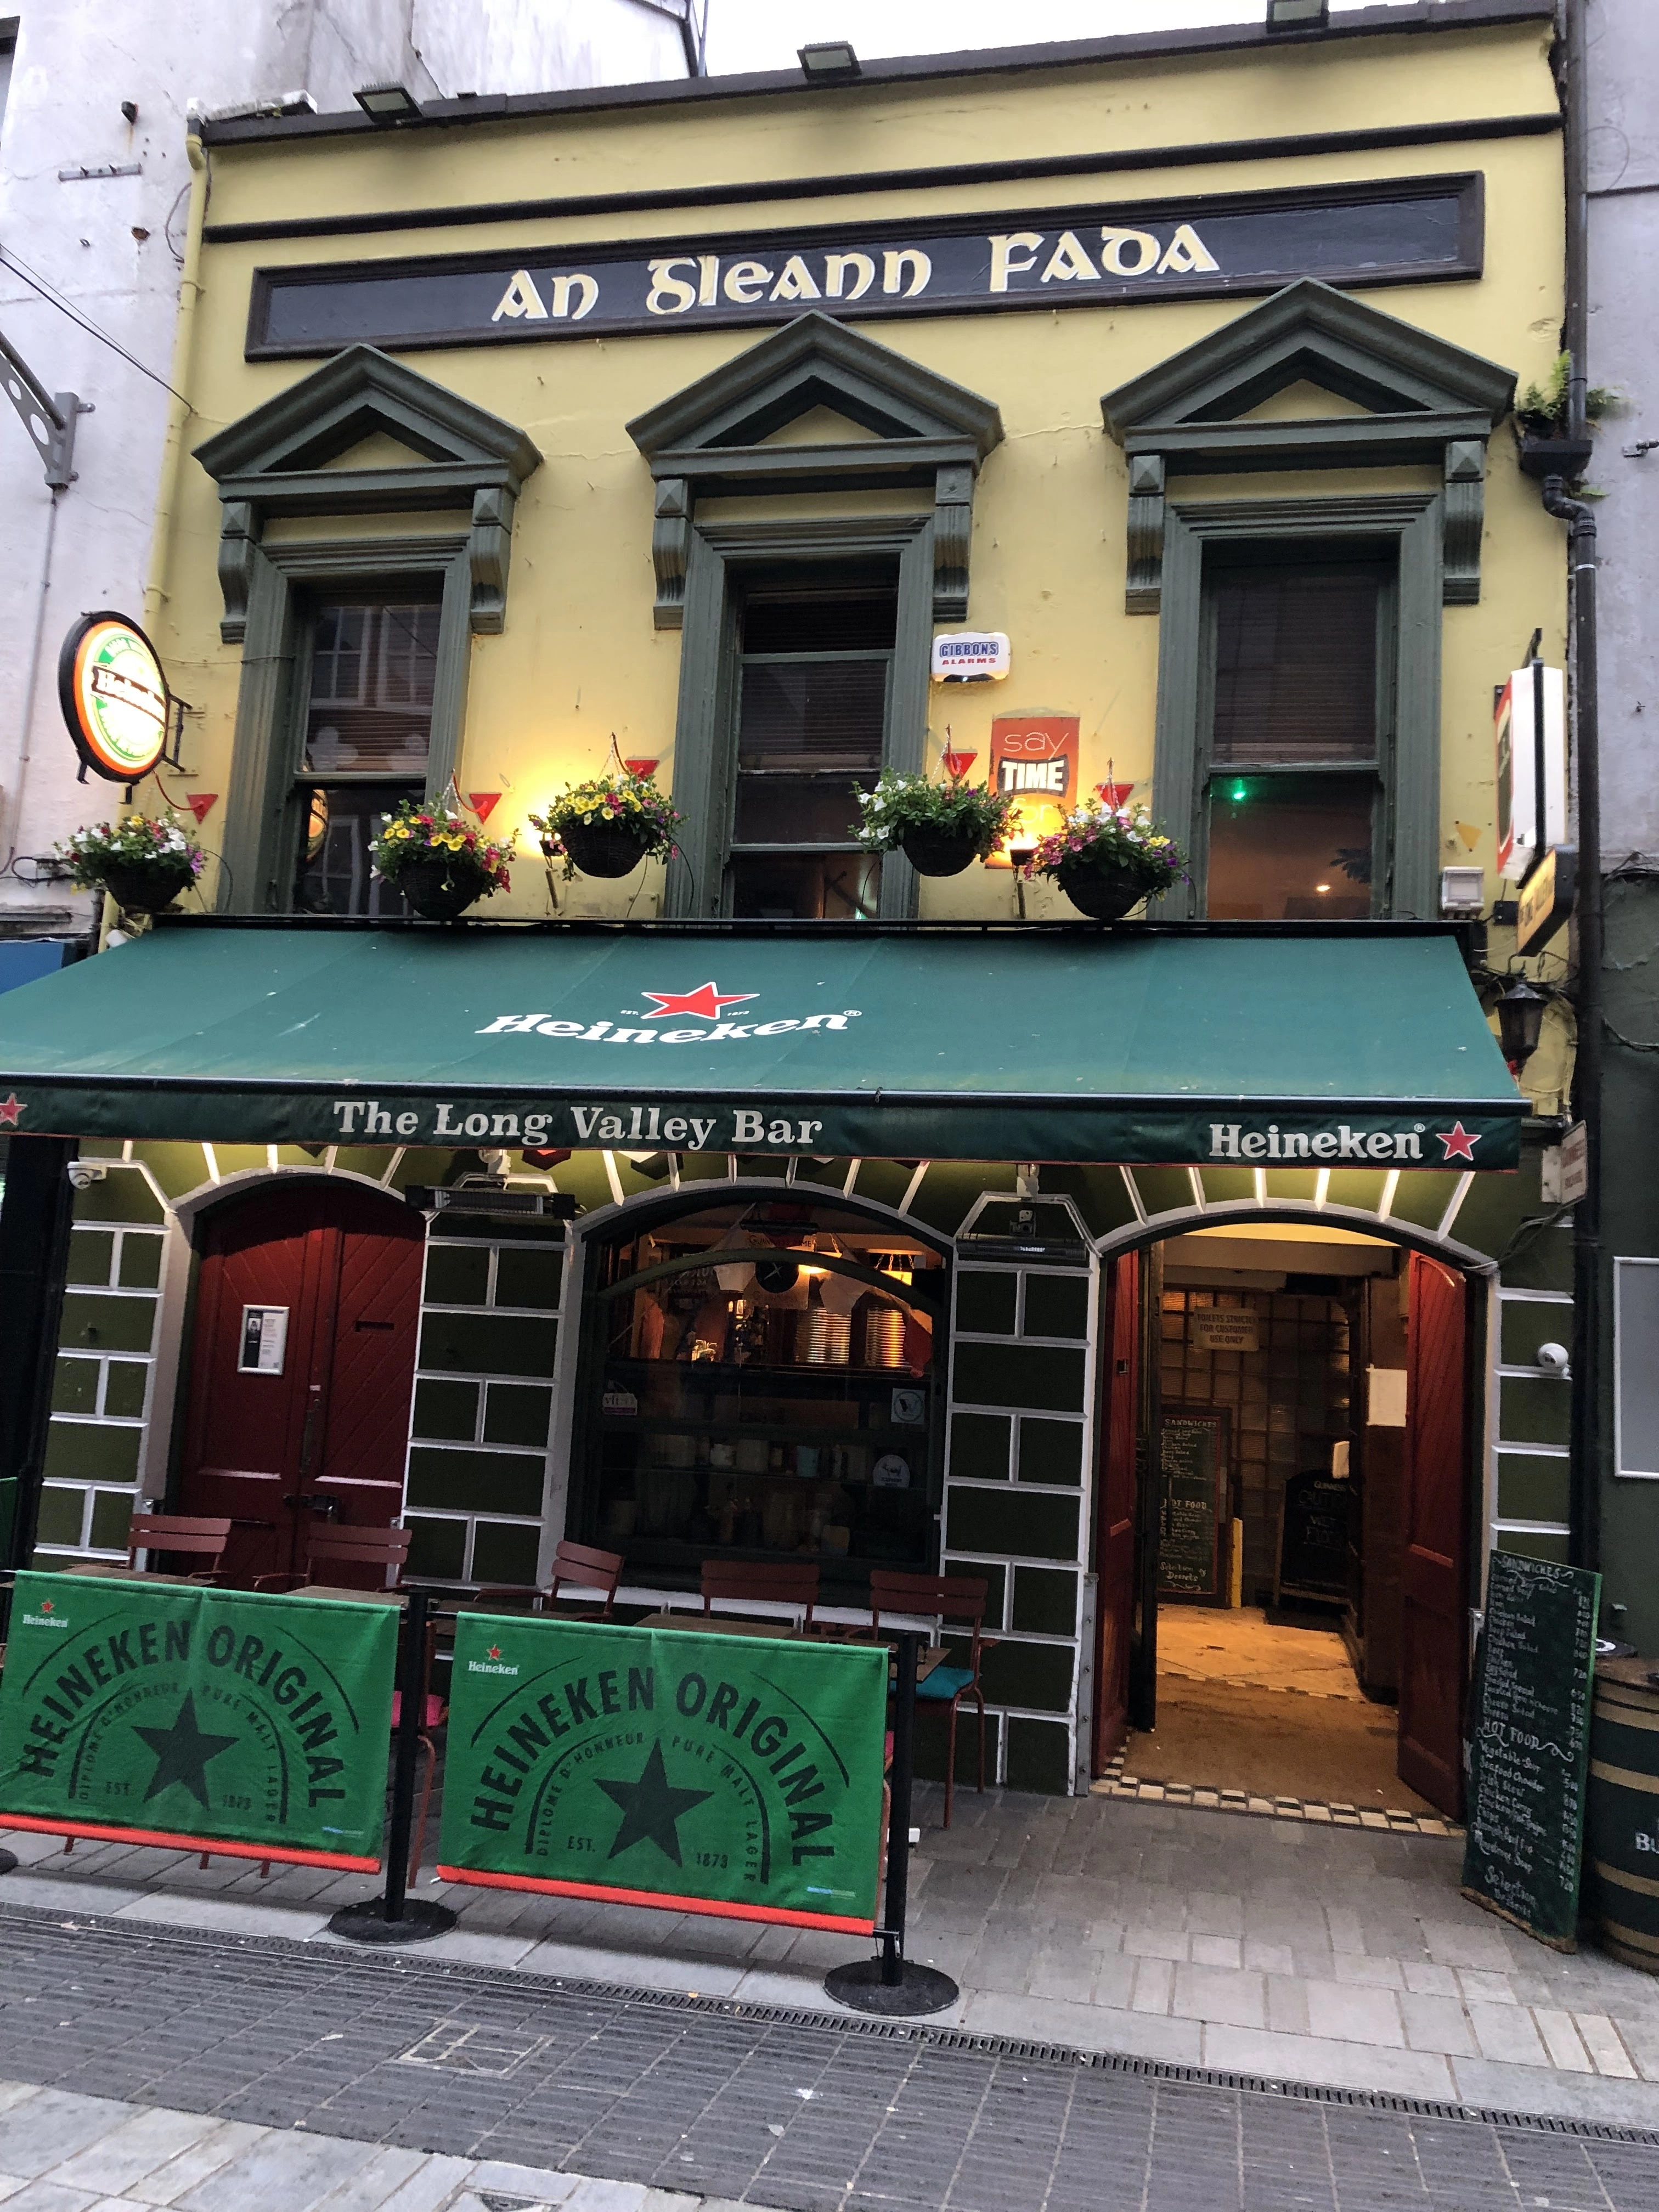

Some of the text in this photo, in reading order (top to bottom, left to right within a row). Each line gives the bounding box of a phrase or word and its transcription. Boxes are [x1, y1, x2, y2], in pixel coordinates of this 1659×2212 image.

[492, 269, 599, 321] An
[940, 642, 999, 657] GIBBONS
[1004, 732, 1069, 760] say
[1002, 759, 1064, 792] TIME
[475, 1011, 849, 1044] Heineken
[334, 1101, 822, 1150] The Long Valley Bar
[1209, 1124, 1424, 1159] Heineken
[1197, 1313, 1224, 1323] TOILETS
[1200, 1324, 1214, 1333] FOR
[1210, 1335, 1244, 1344] USE ONLY
[1165, 1419, 1217, 1427] SANDWICHES
[1185, 1500, 1207, 1509] FOOD
[1502, 1555, 1561, 1578] SANDWICHES
[22, 1614, 68, 1628] Heineken
[468, 1660, 518, 1675] Heineken
[21, 1620, 346, 1808] HEINEKEN ORIGINAL
[1483, 1717, 1539, 1750] HOT FOOD
[470, 1667, 836, 1867] HEINEKEN ORIGINAL
[537, 1785, 562, 1857] DIPLOME
[672, 1735, 714, 1763] PURE
[720, 1763, 755, 1806] MALT
[743, 1820, 759, 1882] LAGER
[567, 1835, 596, 1853] EST.
[697, 1852, 729, 1869] 1873
